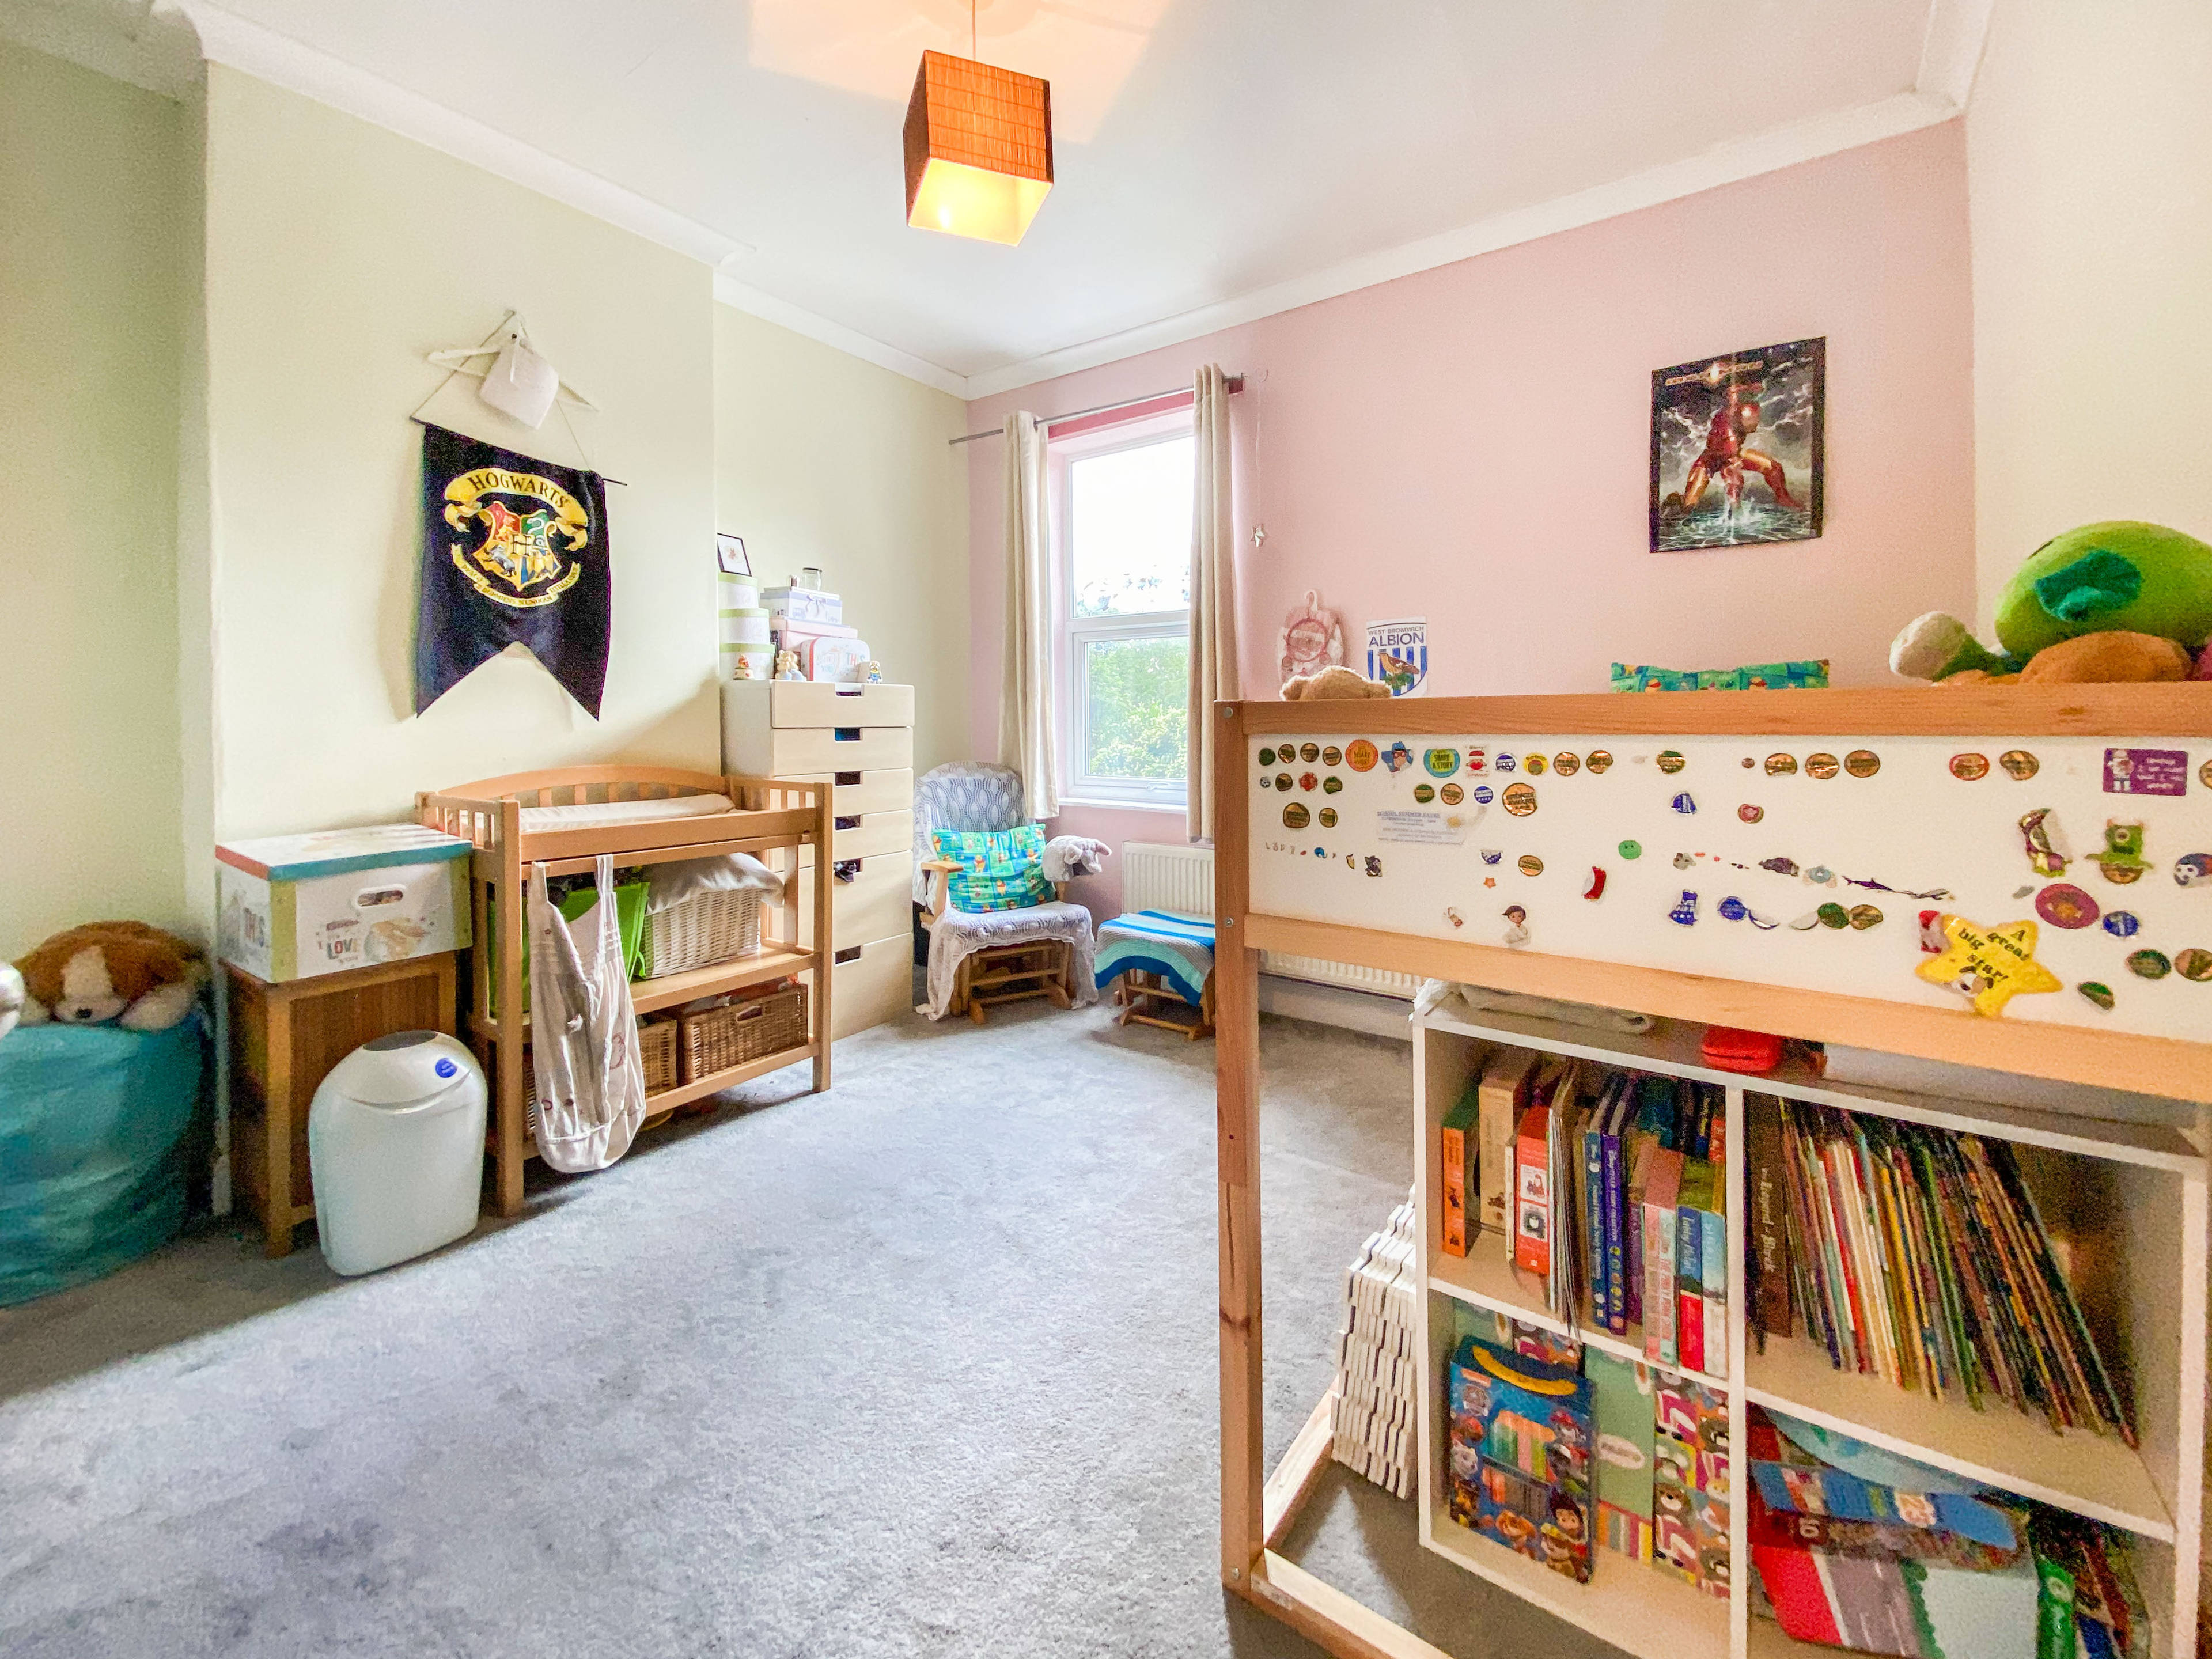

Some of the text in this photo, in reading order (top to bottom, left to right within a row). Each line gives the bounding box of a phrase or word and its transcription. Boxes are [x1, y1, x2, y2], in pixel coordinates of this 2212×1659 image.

[467, 472, 568, 507] HOGWARTS
[1368, 632, 1425, 647] ALBION
[1958, 927, 1985, 950] big
[1986, 932, 2029, 961] great
[2010, 929, 2025, 942] A
